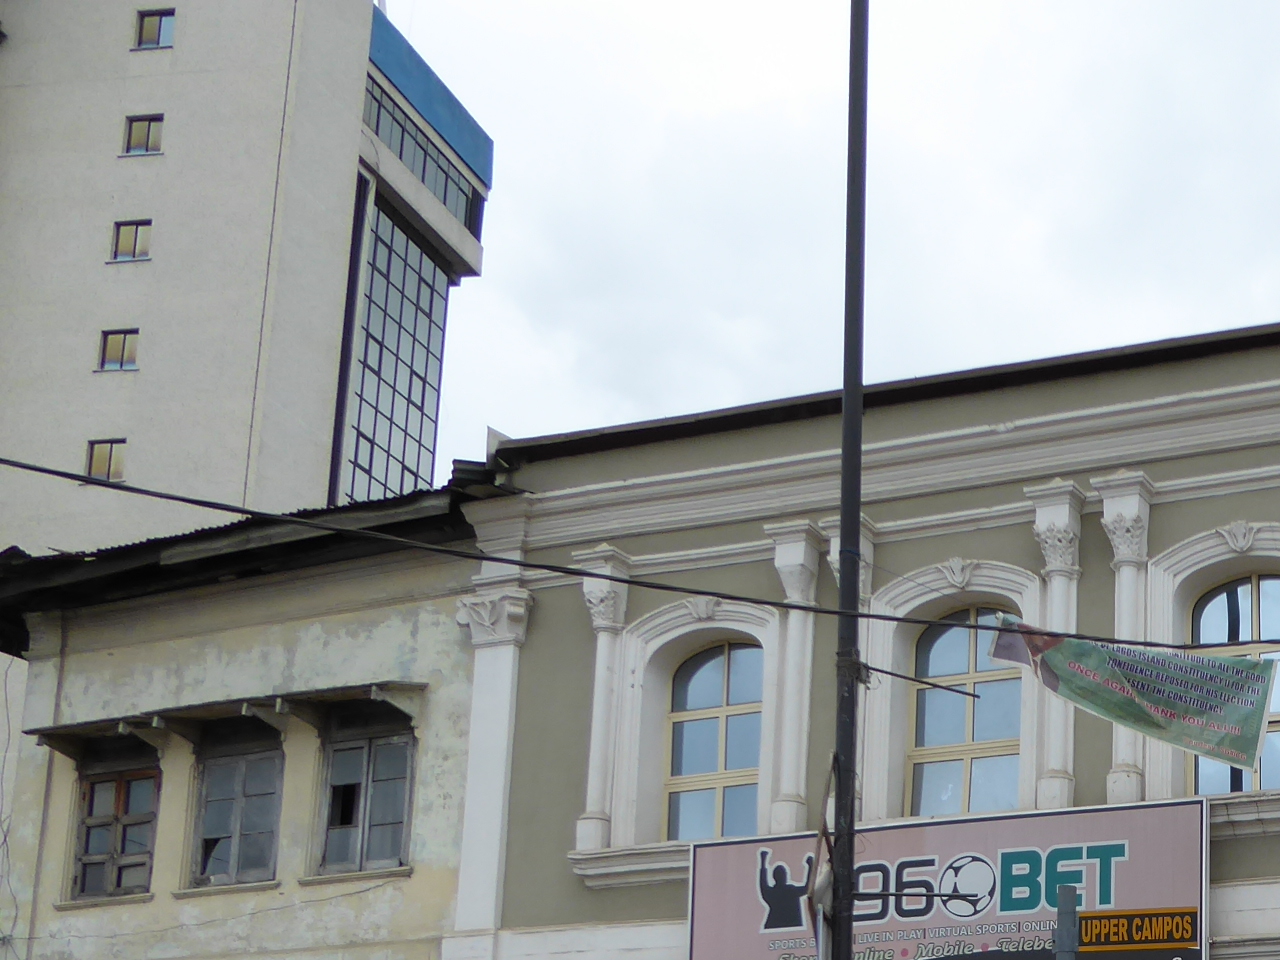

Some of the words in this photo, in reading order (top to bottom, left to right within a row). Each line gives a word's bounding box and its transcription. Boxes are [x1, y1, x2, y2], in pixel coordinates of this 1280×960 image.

[1112, 644, 1137, 659] LAGOS
[1138, 650, 1167, 668] ISLAND
[1167, 660, 1224, 685] CONSTITUENCY
[1230, 680, 1246, 693] FOR
[1246, 685, 1261, 696] THE
[1207, 658, 1217, 669] TO
[1217, 662, 1230, 674] ALL
[1231, 666, 1244, 678] THE
[1245, 670, 1267, 685] GOOD
[1068, 660, 1100, 682] ONCE
[1181, 714, 1205, 728] YOU
[1152, 685, 1166, 698] THE
[1155, 671, 1189, 690] REPOSED
[1190, 682, 1205, 695] FOR
[1205, 687, 1219, 699] HIS
[1219, 691, 1256, 708] ELECTION
[768, 937, 807, 951] SPORTS
[858, 932, 880, 945] LIVE
[881, 930, 894, 942] IN
[897, 928, 923, 941] PLAY
[928, 924, 973, 939] VIRTUAL
[976, 922, 1017, 935] SPORTS
[1023, 919, 1058, 933] ONLIN
[1081, 917, 1128, 943] UPPER
[1132, 914, 1193, 940] CAMPOS
[914, 940, 975, 960] Mobile
